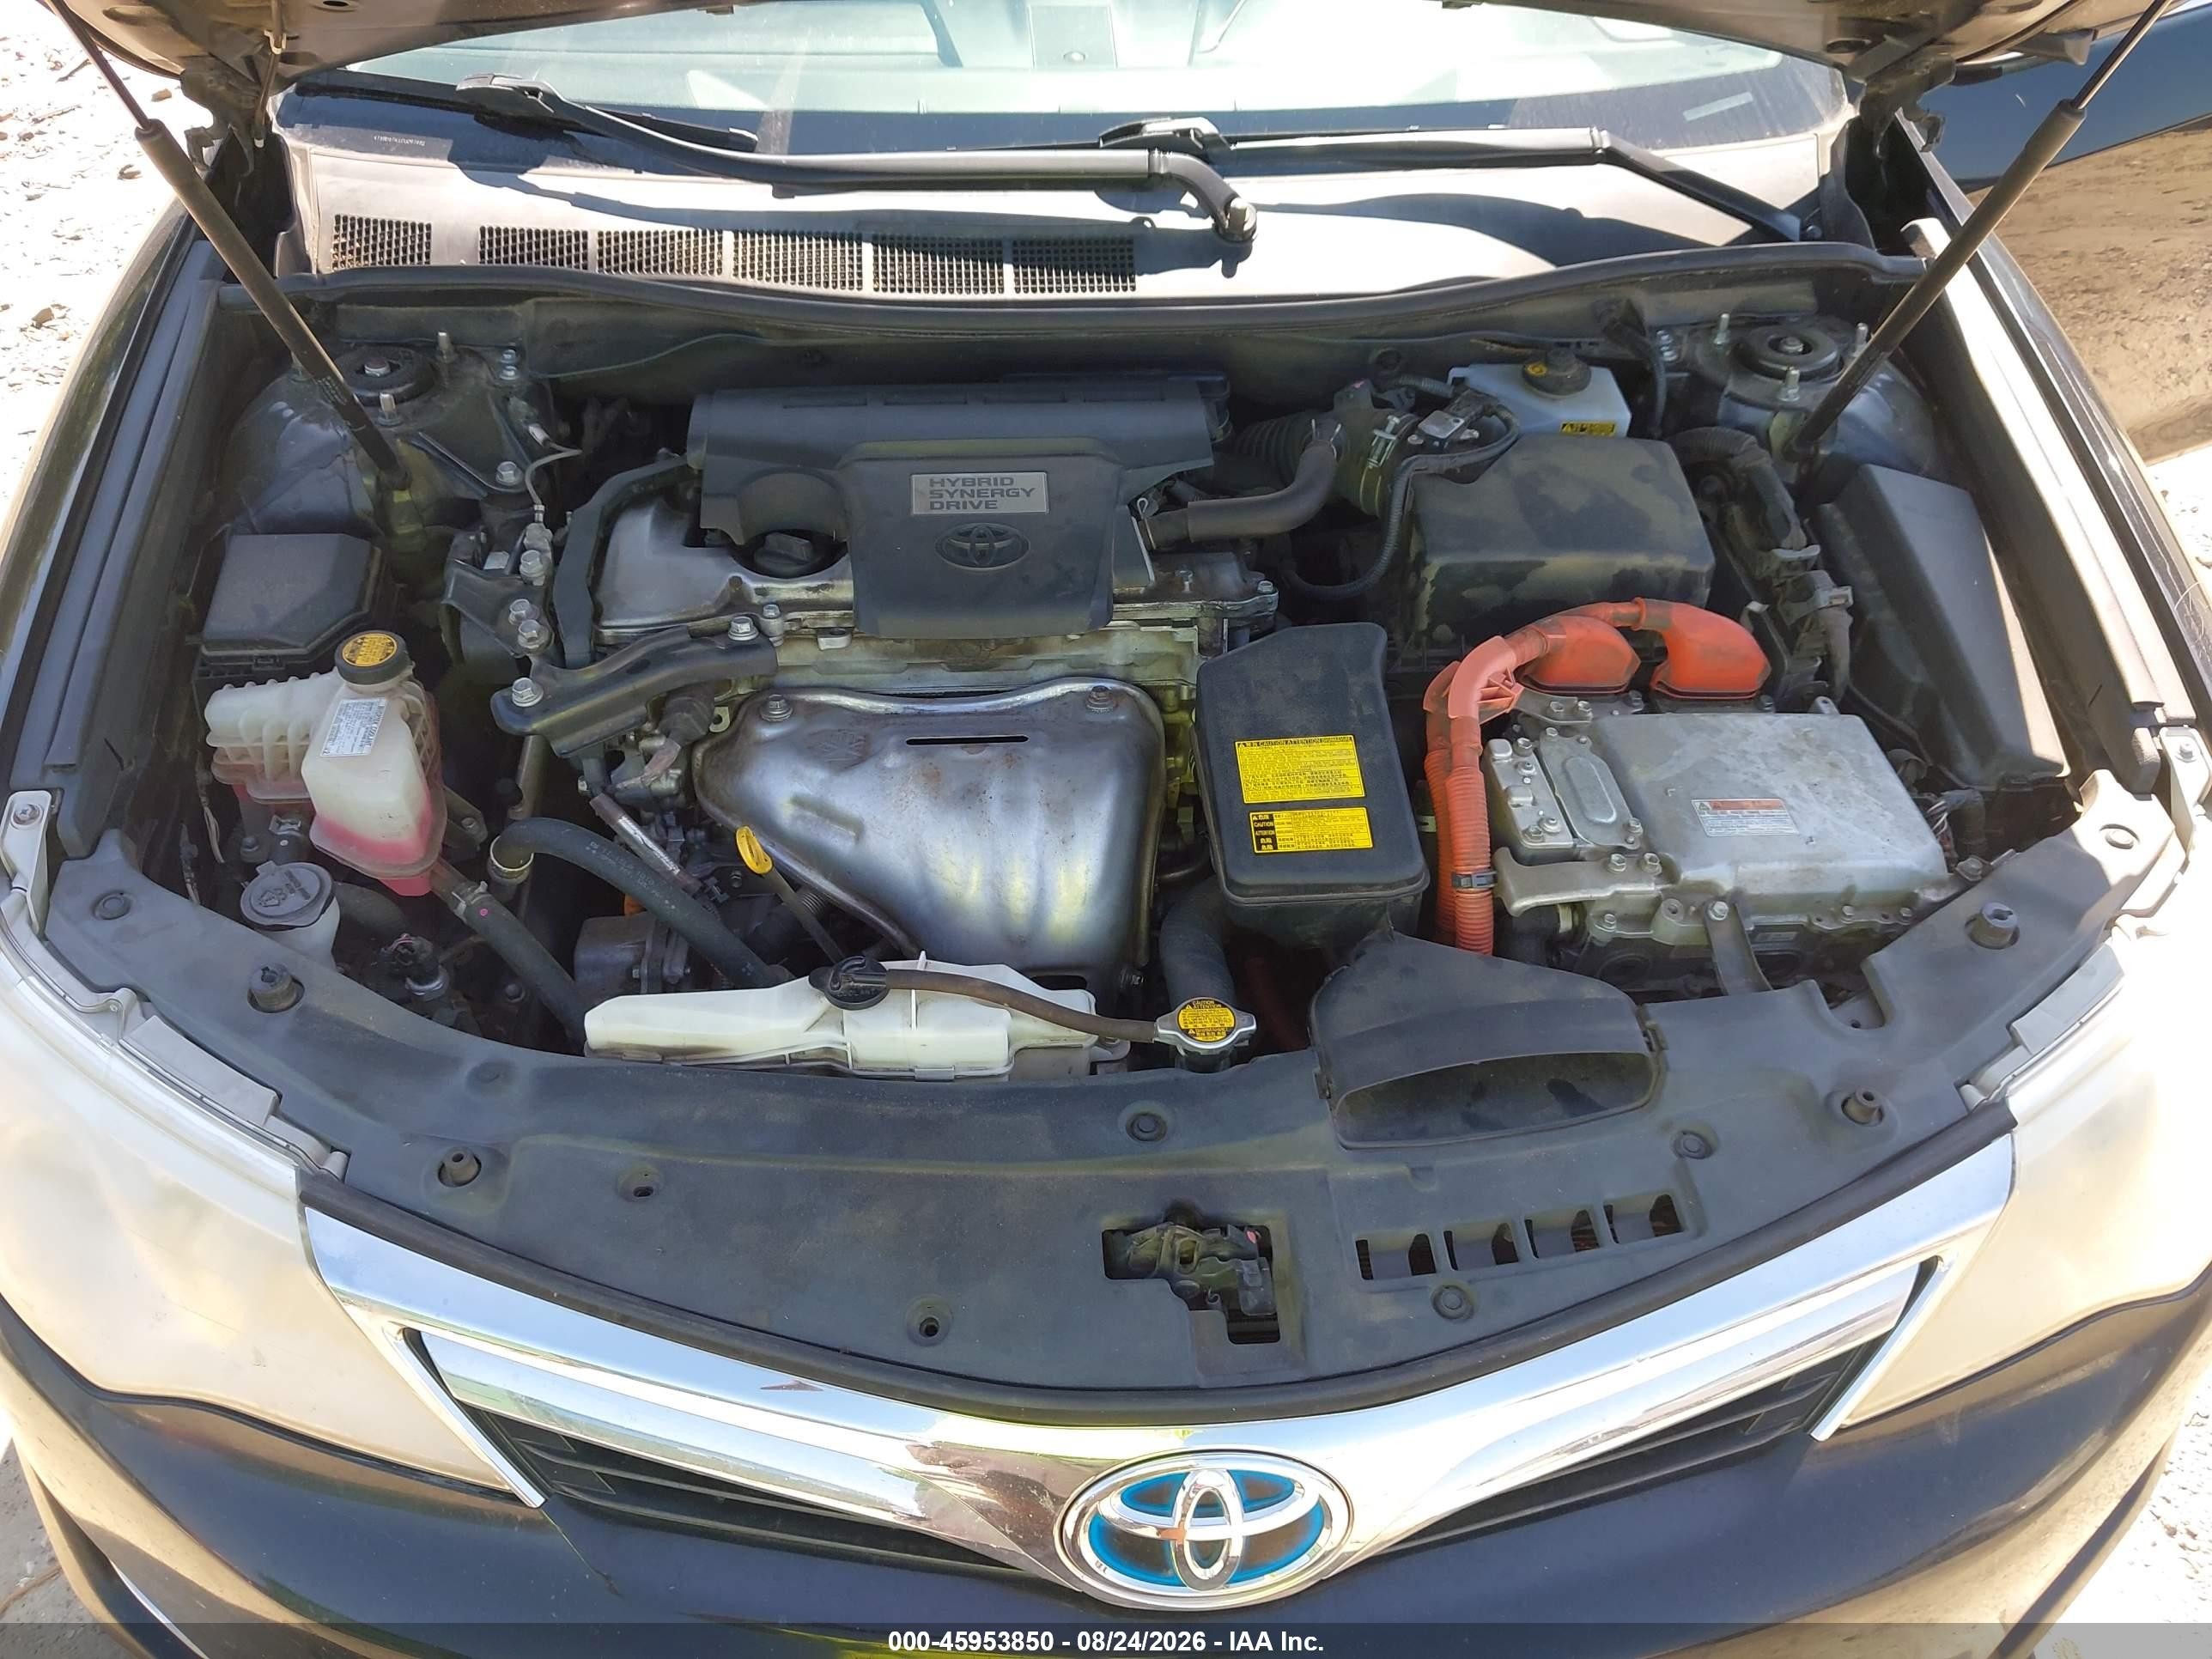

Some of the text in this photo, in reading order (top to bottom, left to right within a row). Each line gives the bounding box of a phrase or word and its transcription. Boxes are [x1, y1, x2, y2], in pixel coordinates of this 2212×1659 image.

[929, 477, 1014, 488] HYBRID
[929, 488, 1036, 499] SYNERGY
[930, 500, 998, 511] DRIVE
